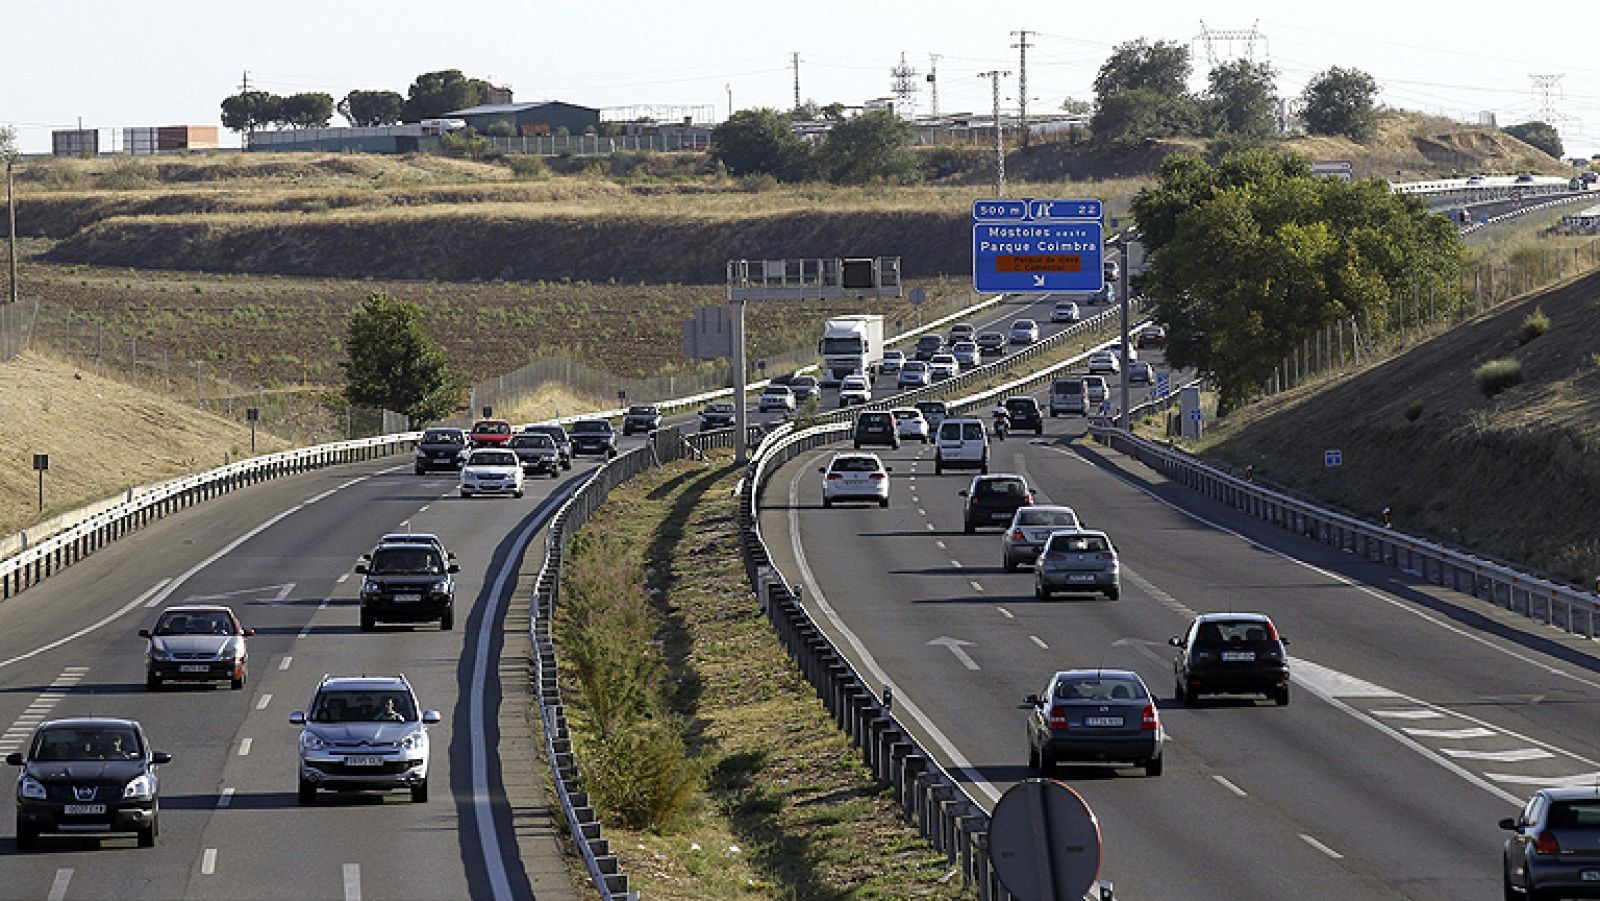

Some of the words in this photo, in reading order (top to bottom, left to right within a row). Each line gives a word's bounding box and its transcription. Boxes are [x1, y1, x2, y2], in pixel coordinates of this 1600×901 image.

[980, 206, 1005, 215] 500
[1010, 207, 1020, 215] m
[1078, 205, 1096, 215] 22
[980, 241, 1030, 253] Parque
[1037, 241, 1097, 251] Coimbra
